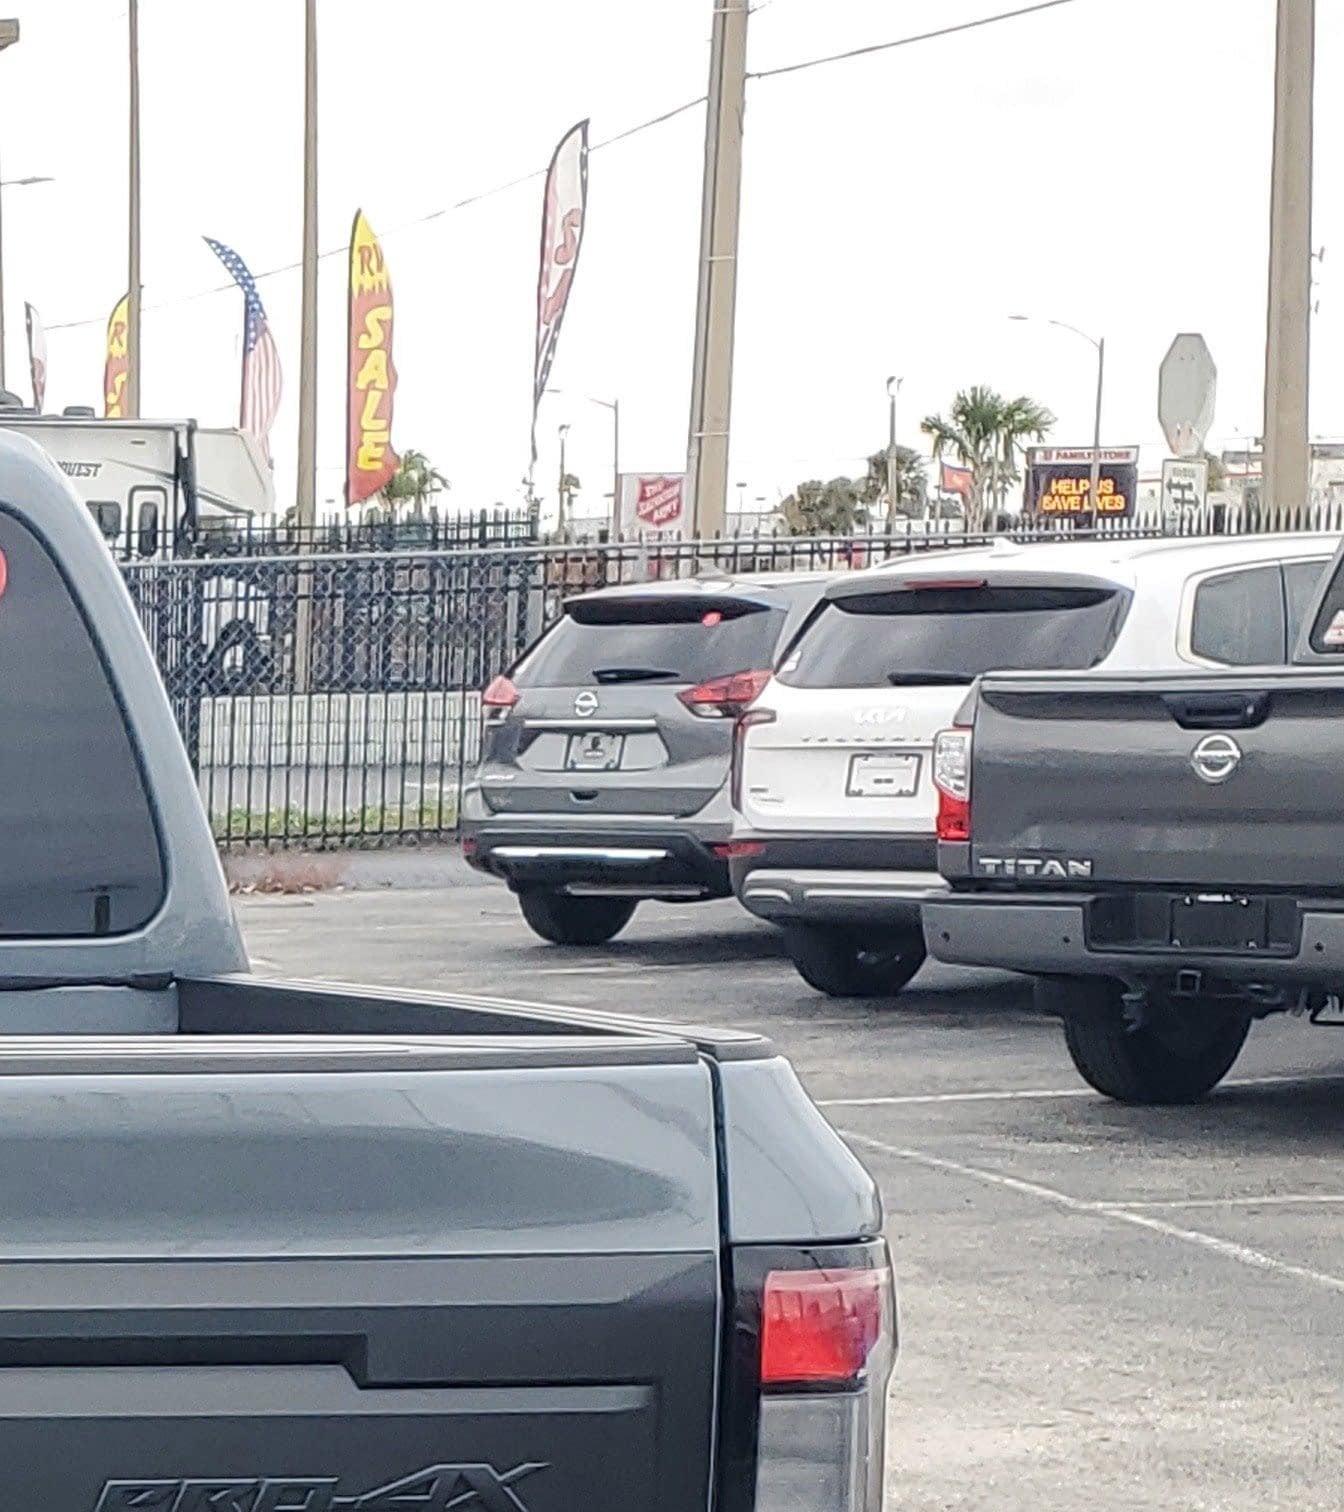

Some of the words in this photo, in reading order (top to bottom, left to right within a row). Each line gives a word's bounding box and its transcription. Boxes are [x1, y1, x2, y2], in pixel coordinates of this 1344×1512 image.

[355, 303, 394, 471] SALE
[1051, 480, 1089, 495] HELP
[1042, 495, 1080, 511] SAVE
[1083, 495, 1125, 511] LVES
[978, 857, 1093, 878] TITAN
